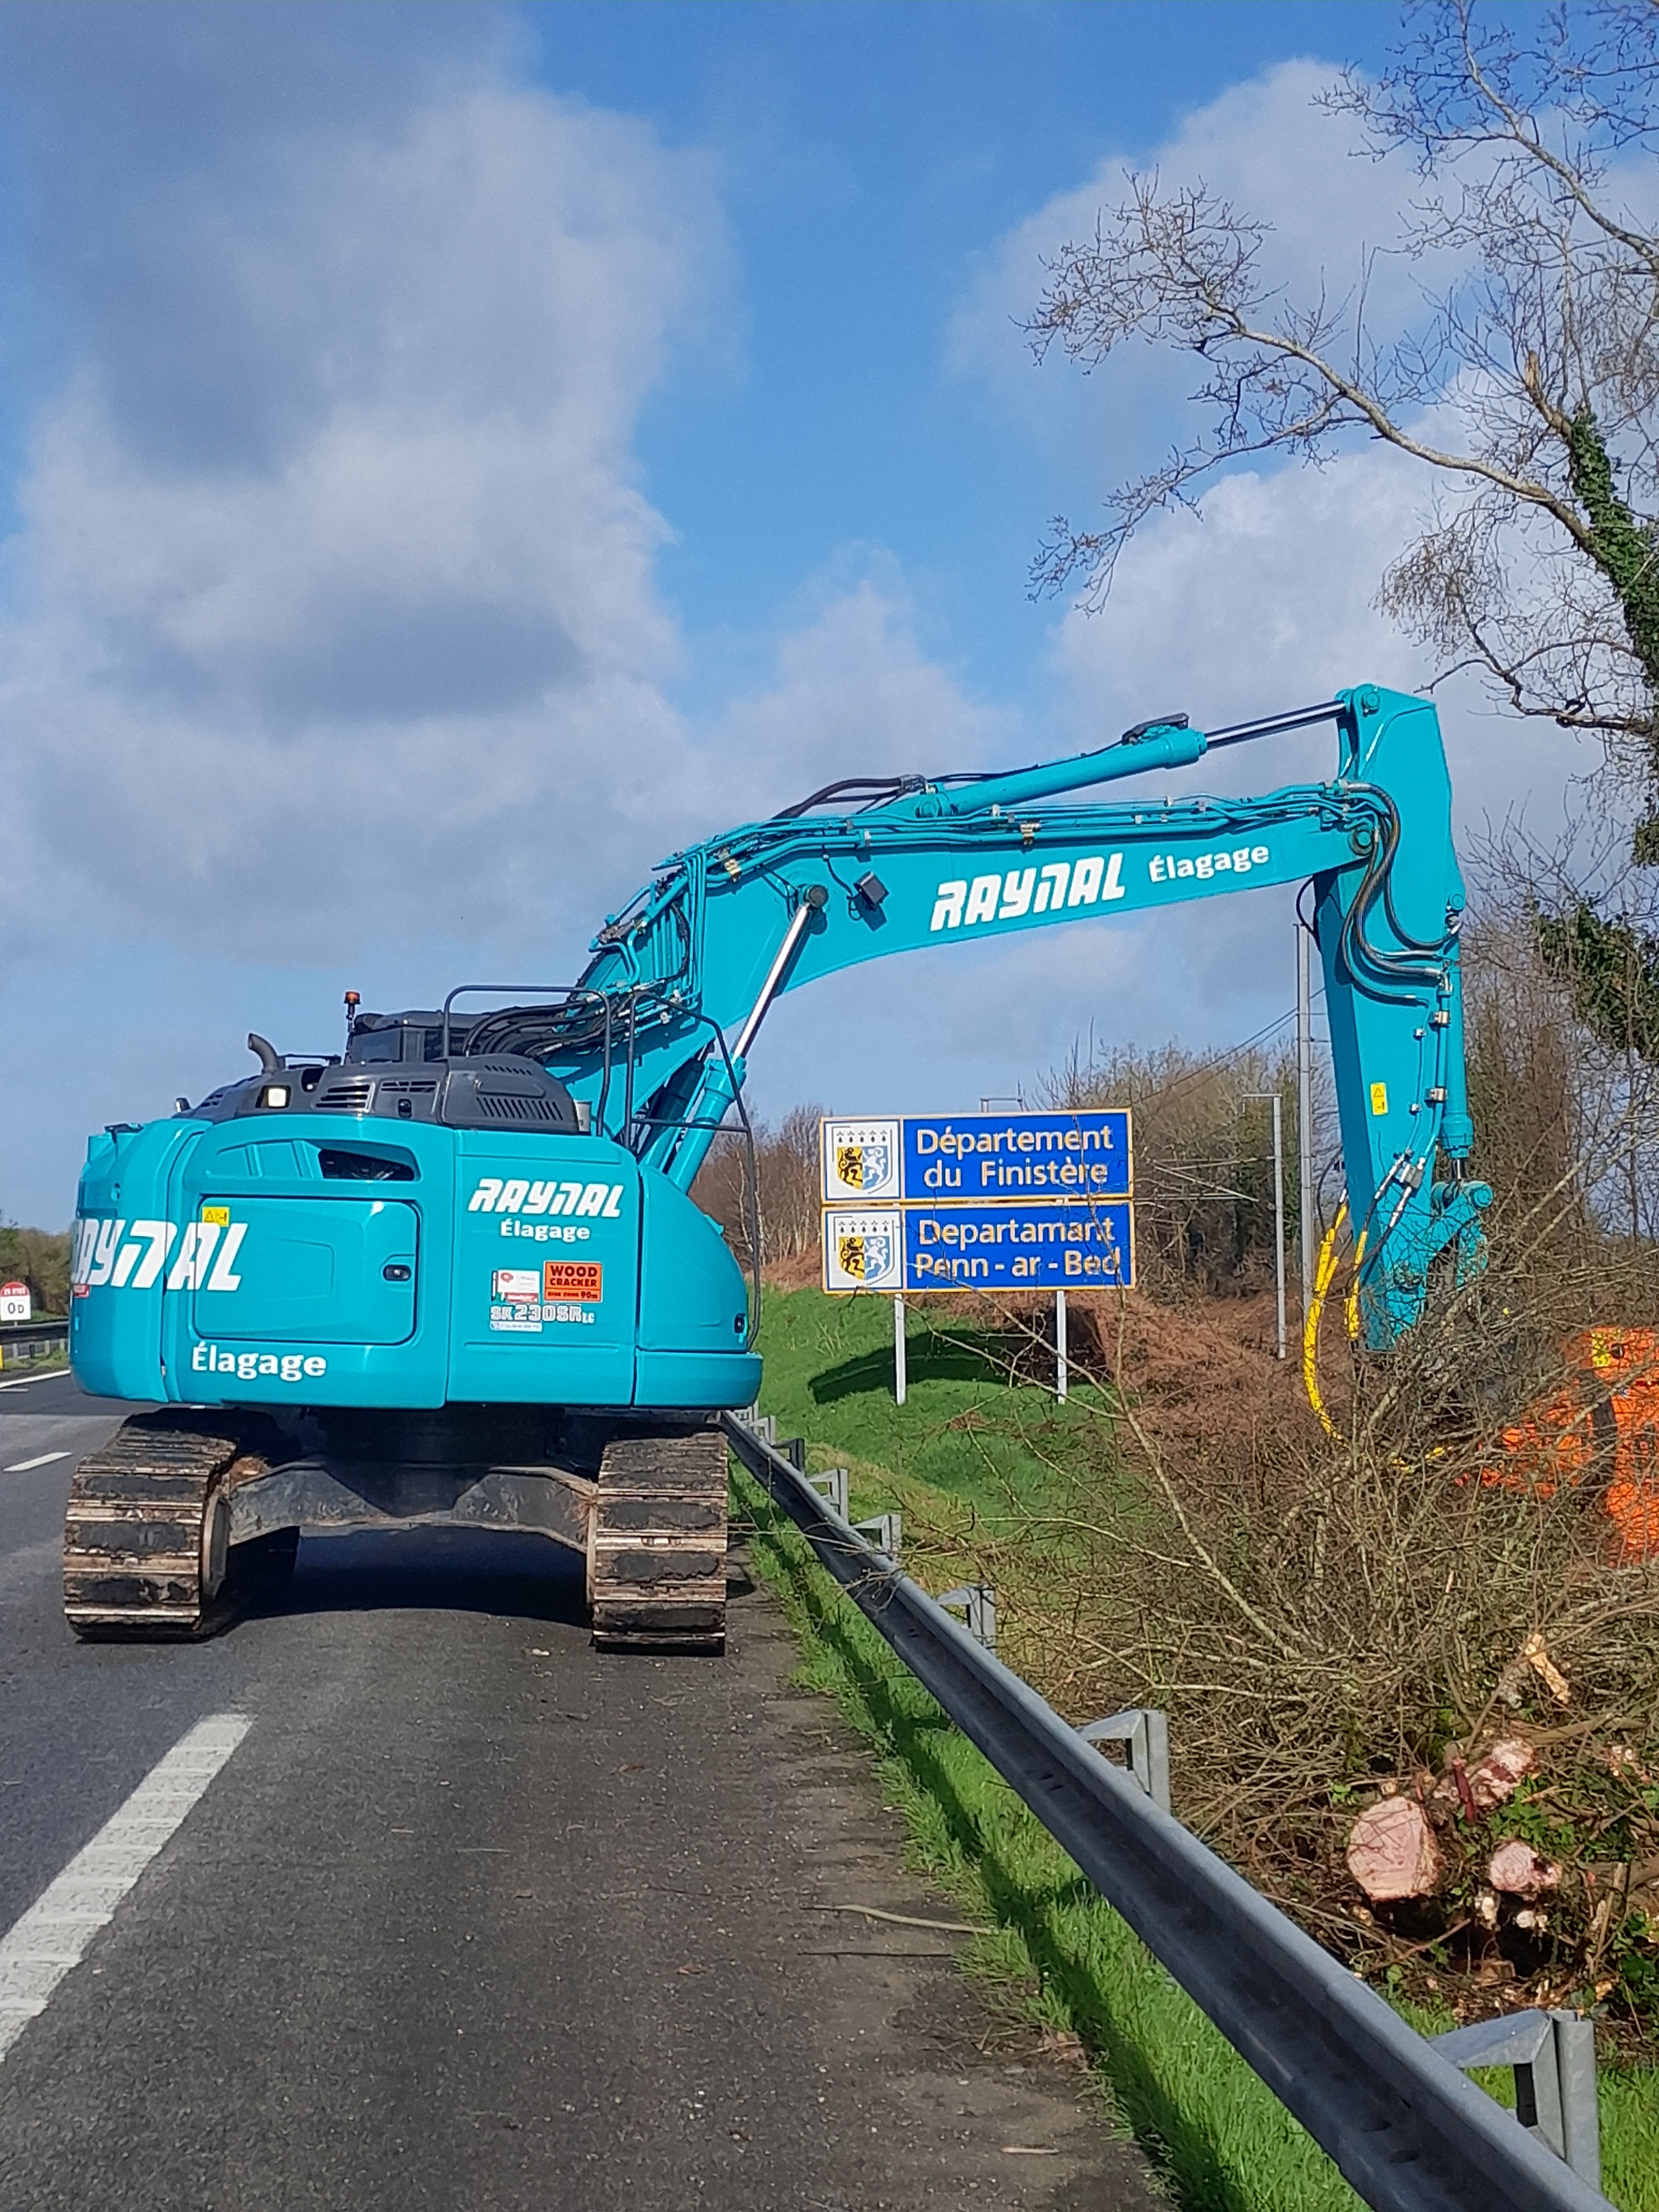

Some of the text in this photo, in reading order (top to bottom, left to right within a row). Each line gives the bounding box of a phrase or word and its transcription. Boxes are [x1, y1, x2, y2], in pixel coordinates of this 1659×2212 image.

[930, 846, 1269, 931] RAYNAL Élagage
[917, 1125, 1114, 1160] Département
[924, 1157, 1108, 1188] du Finistère
[468, 1178, 624, 1217] RAYNAL
[500, 1218, 590, 1242] Élagage
[919, 1217, 1116, 1251] Departamant
[550, 1265, 598, 1277] WOOD
[550, 1278, 597, 1287] CRACKER
[192, 1341, 326, 1381] Élagage
